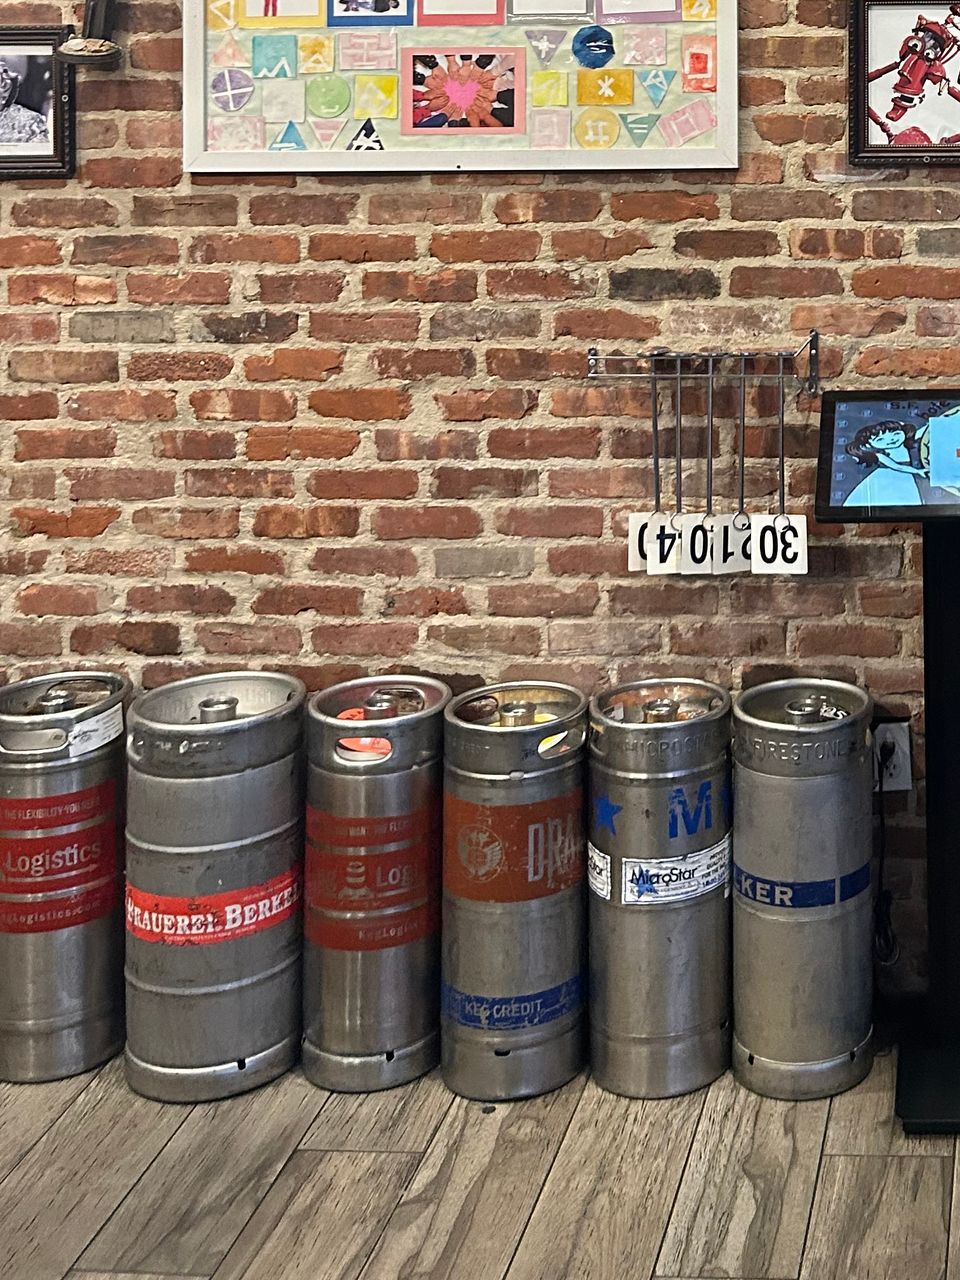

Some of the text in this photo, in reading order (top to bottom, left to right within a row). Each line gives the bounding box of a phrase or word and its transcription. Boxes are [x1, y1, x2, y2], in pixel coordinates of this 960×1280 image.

[759, 524, 800, 565] 30
[667, 780, 713, 839] M
[4, 842, 102, 877] Logistics
[630, 866, 698, 887] MicroStar
[738, 872, 793, 907] KER
[492, 998, 544, 1019] CREDIT
